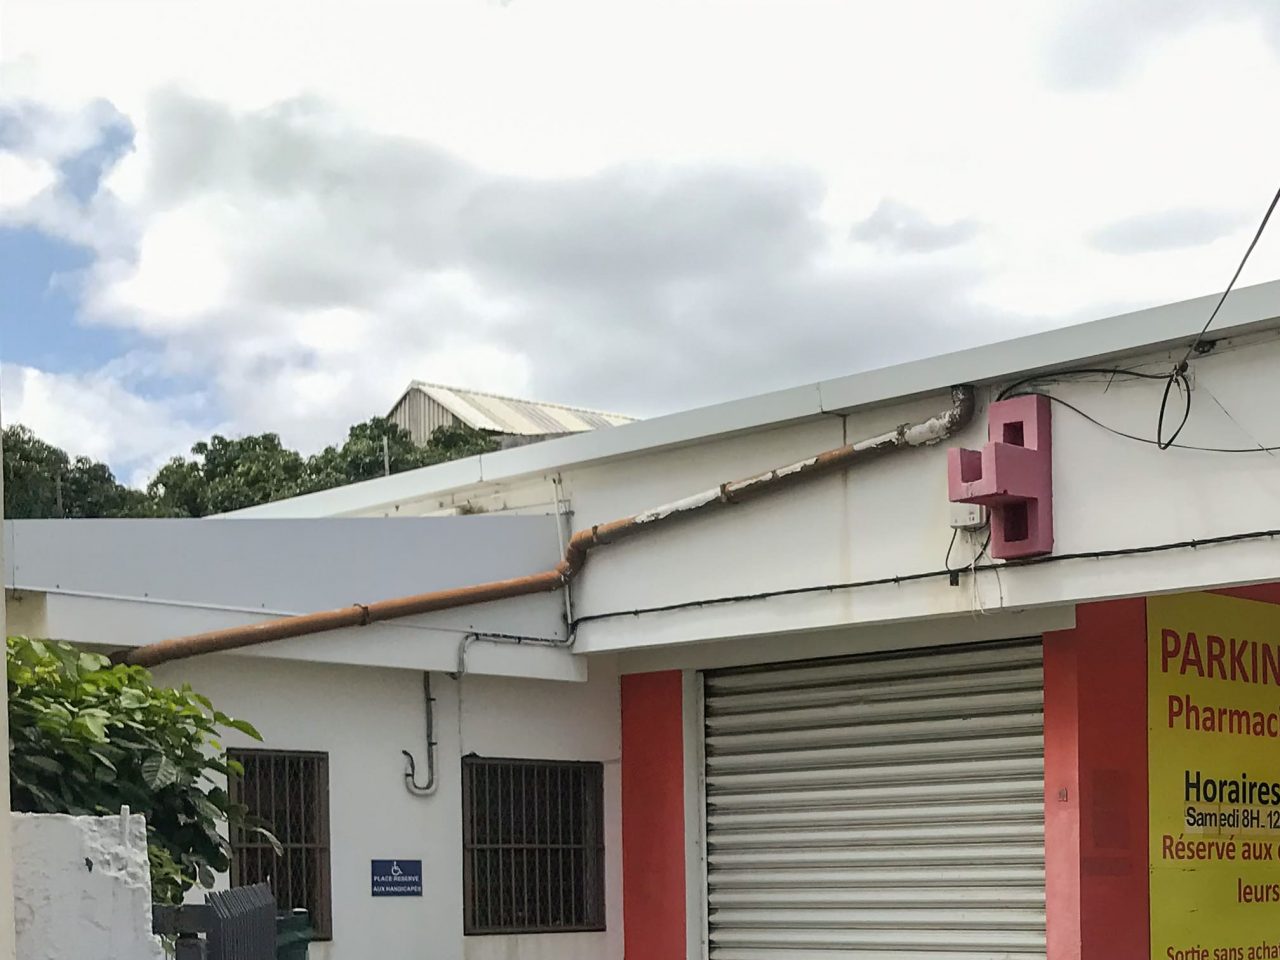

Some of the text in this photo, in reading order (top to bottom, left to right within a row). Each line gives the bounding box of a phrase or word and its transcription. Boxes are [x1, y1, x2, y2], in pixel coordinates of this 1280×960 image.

[1185, 770, 1280, 805] Horaires
[1186, 806, 1240, 828] Samedi
[1162, 833, 1236, 861] Réservé
[1242, 842, 1272, 861] aux
[1238, 878, 1280, 903] leurs
